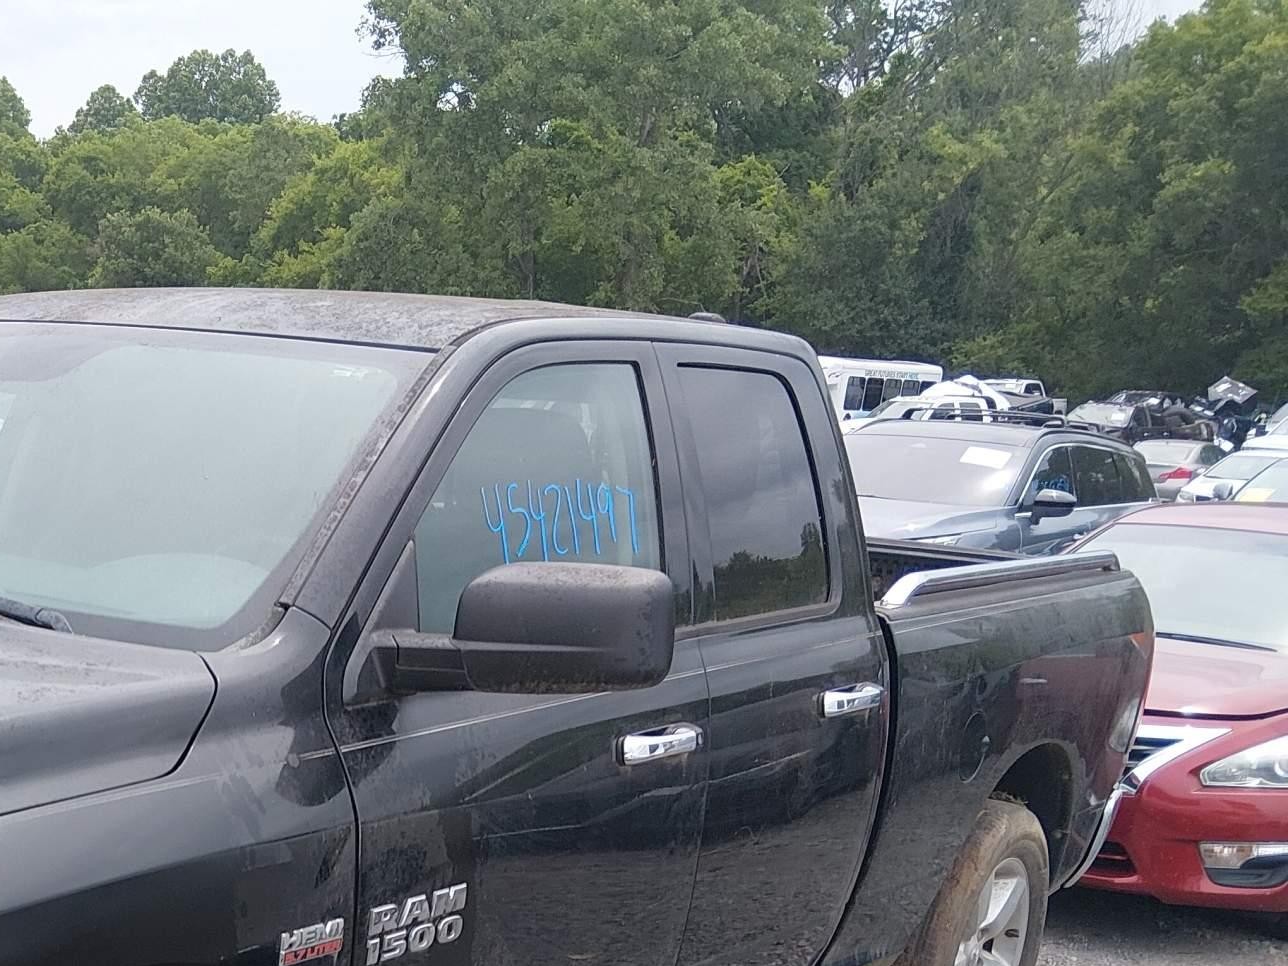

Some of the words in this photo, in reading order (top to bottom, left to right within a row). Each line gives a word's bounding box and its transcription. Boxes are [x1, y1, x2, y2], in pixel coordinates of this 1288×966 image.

[480, 478, 639, 565] 45421497
[281, 918, 344, 951] HEMI
[365, 882, 467, 937] RAM
[366, 914, 463, 966] 1500
